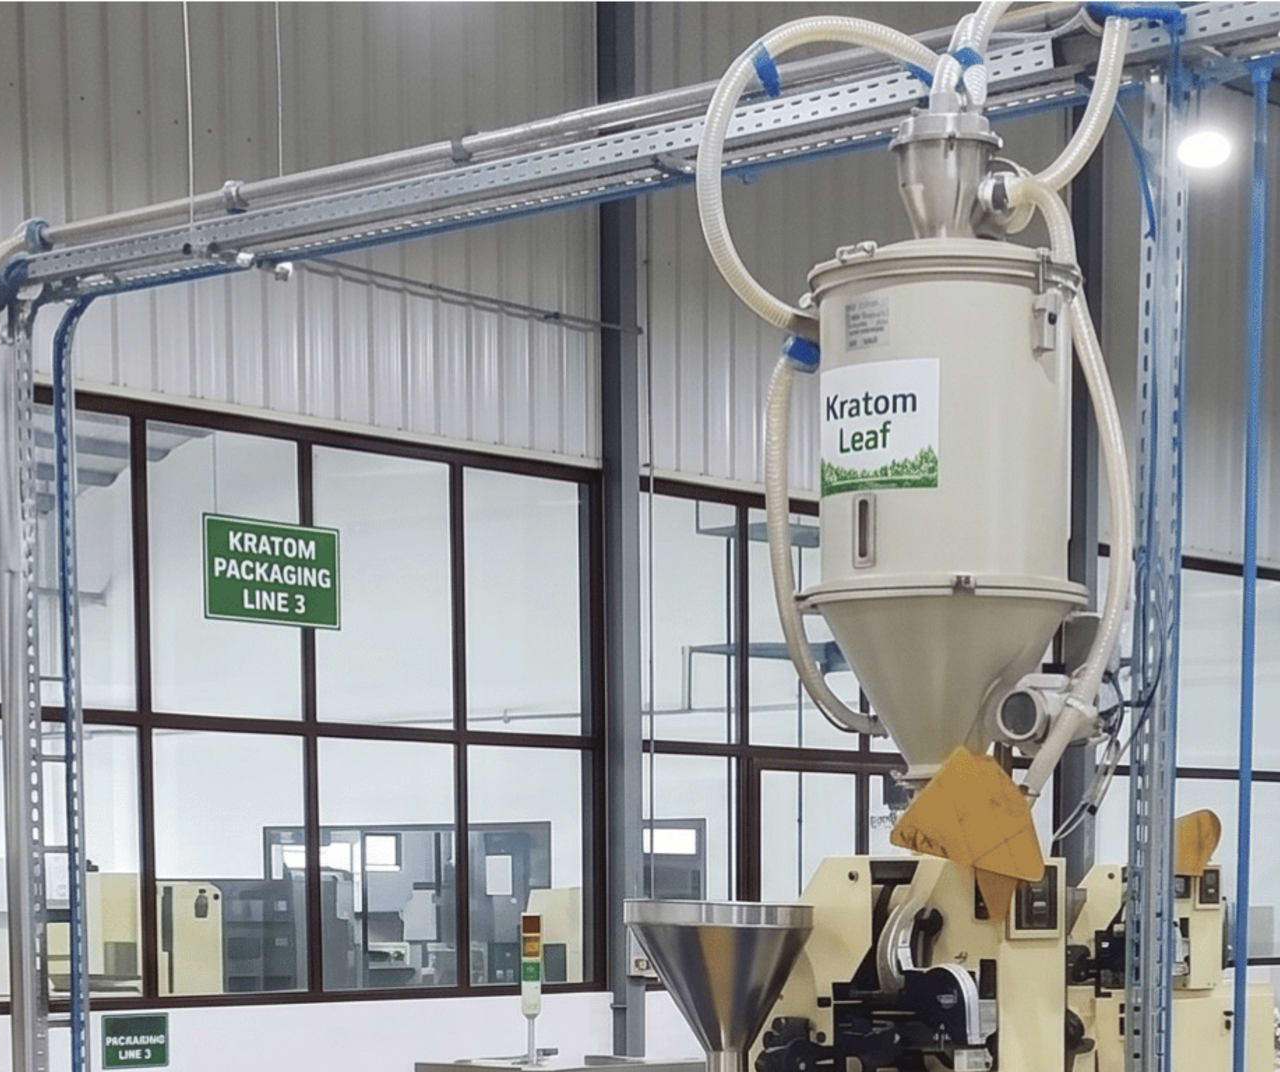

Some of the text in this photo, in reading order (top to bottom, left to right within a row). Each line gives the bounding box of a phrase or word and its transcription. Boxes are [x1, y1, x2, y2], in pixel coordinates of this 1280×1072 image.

[825, 390, 917, 422] Kratom
[839, 421, 891, 454] Leaf
[228, 530, 316, 560] KRATOM
[214, 557, 331, 588] PACKAGING
[243, 588, 306, 614] LINE 3
